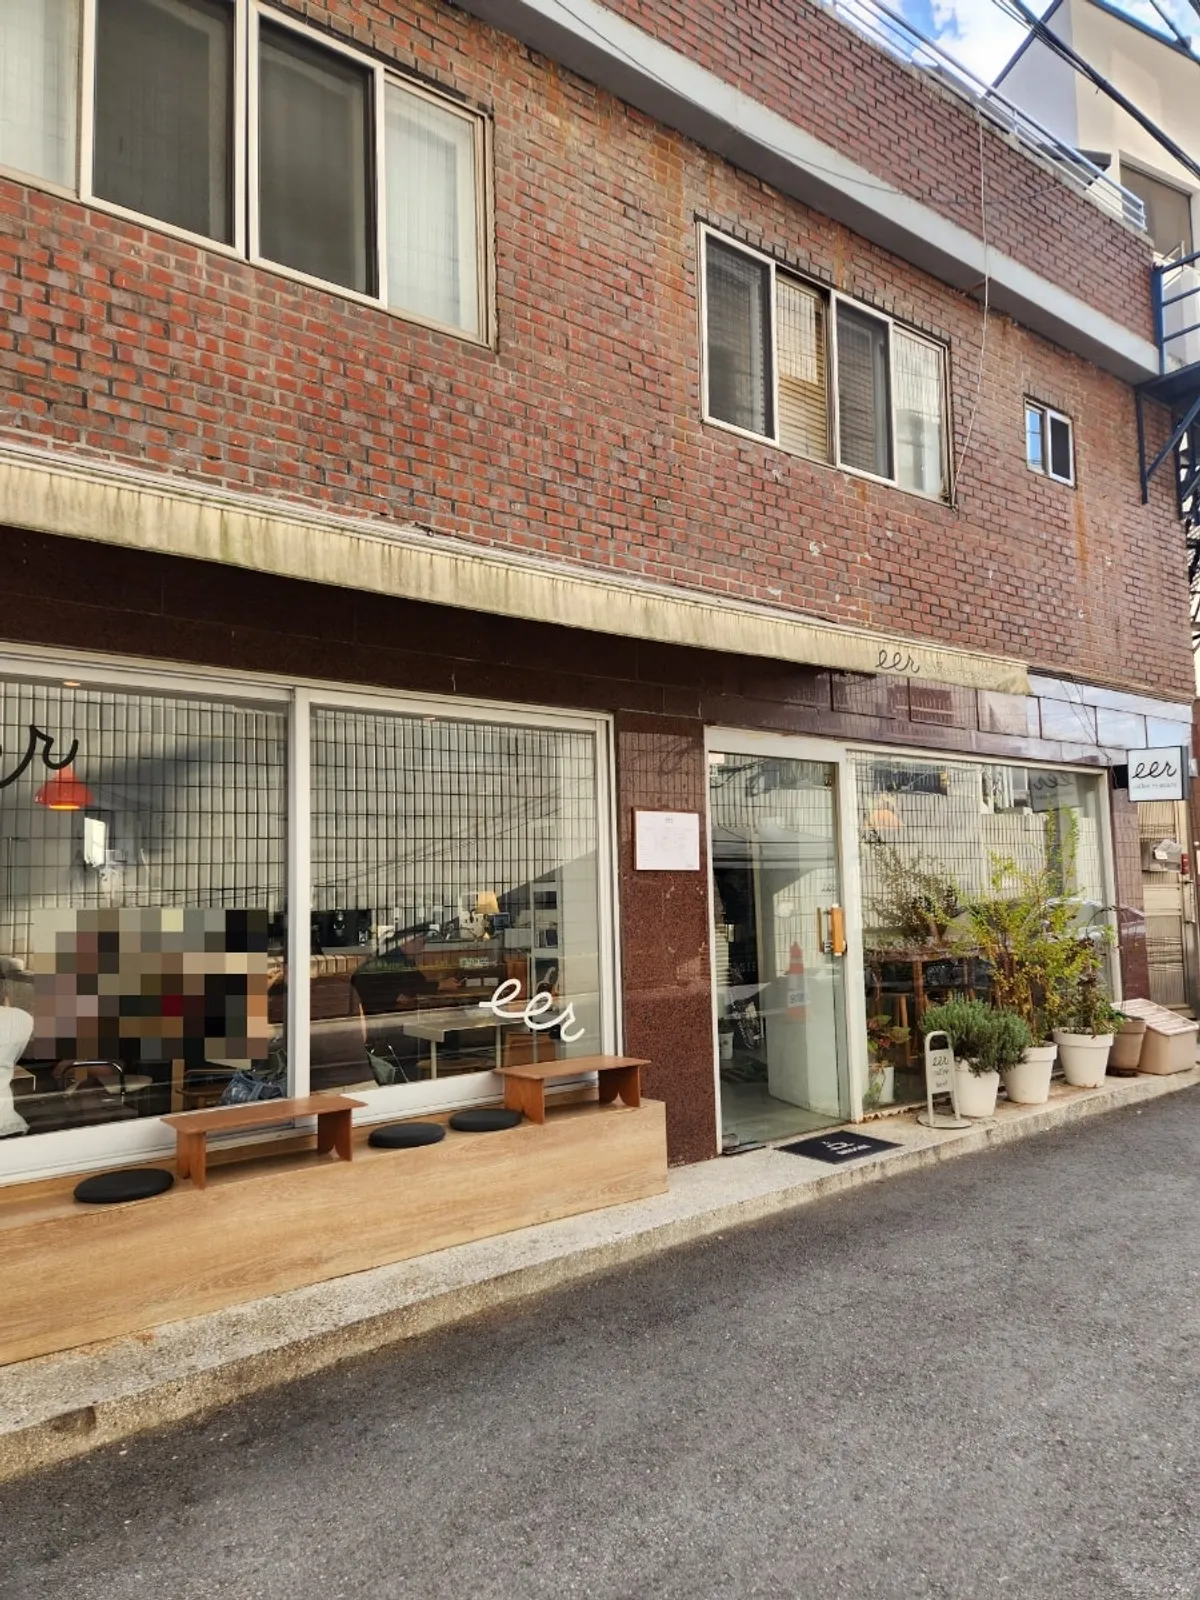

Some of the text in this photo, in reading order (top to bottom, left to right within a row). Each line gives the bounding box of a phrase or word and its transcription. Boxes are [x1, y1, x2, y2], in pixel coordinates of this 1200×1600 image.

[875, 649, 920, 673] eer
[1132, 761, 1177, 779] eer
[479, 979, 585, 1042] eer
